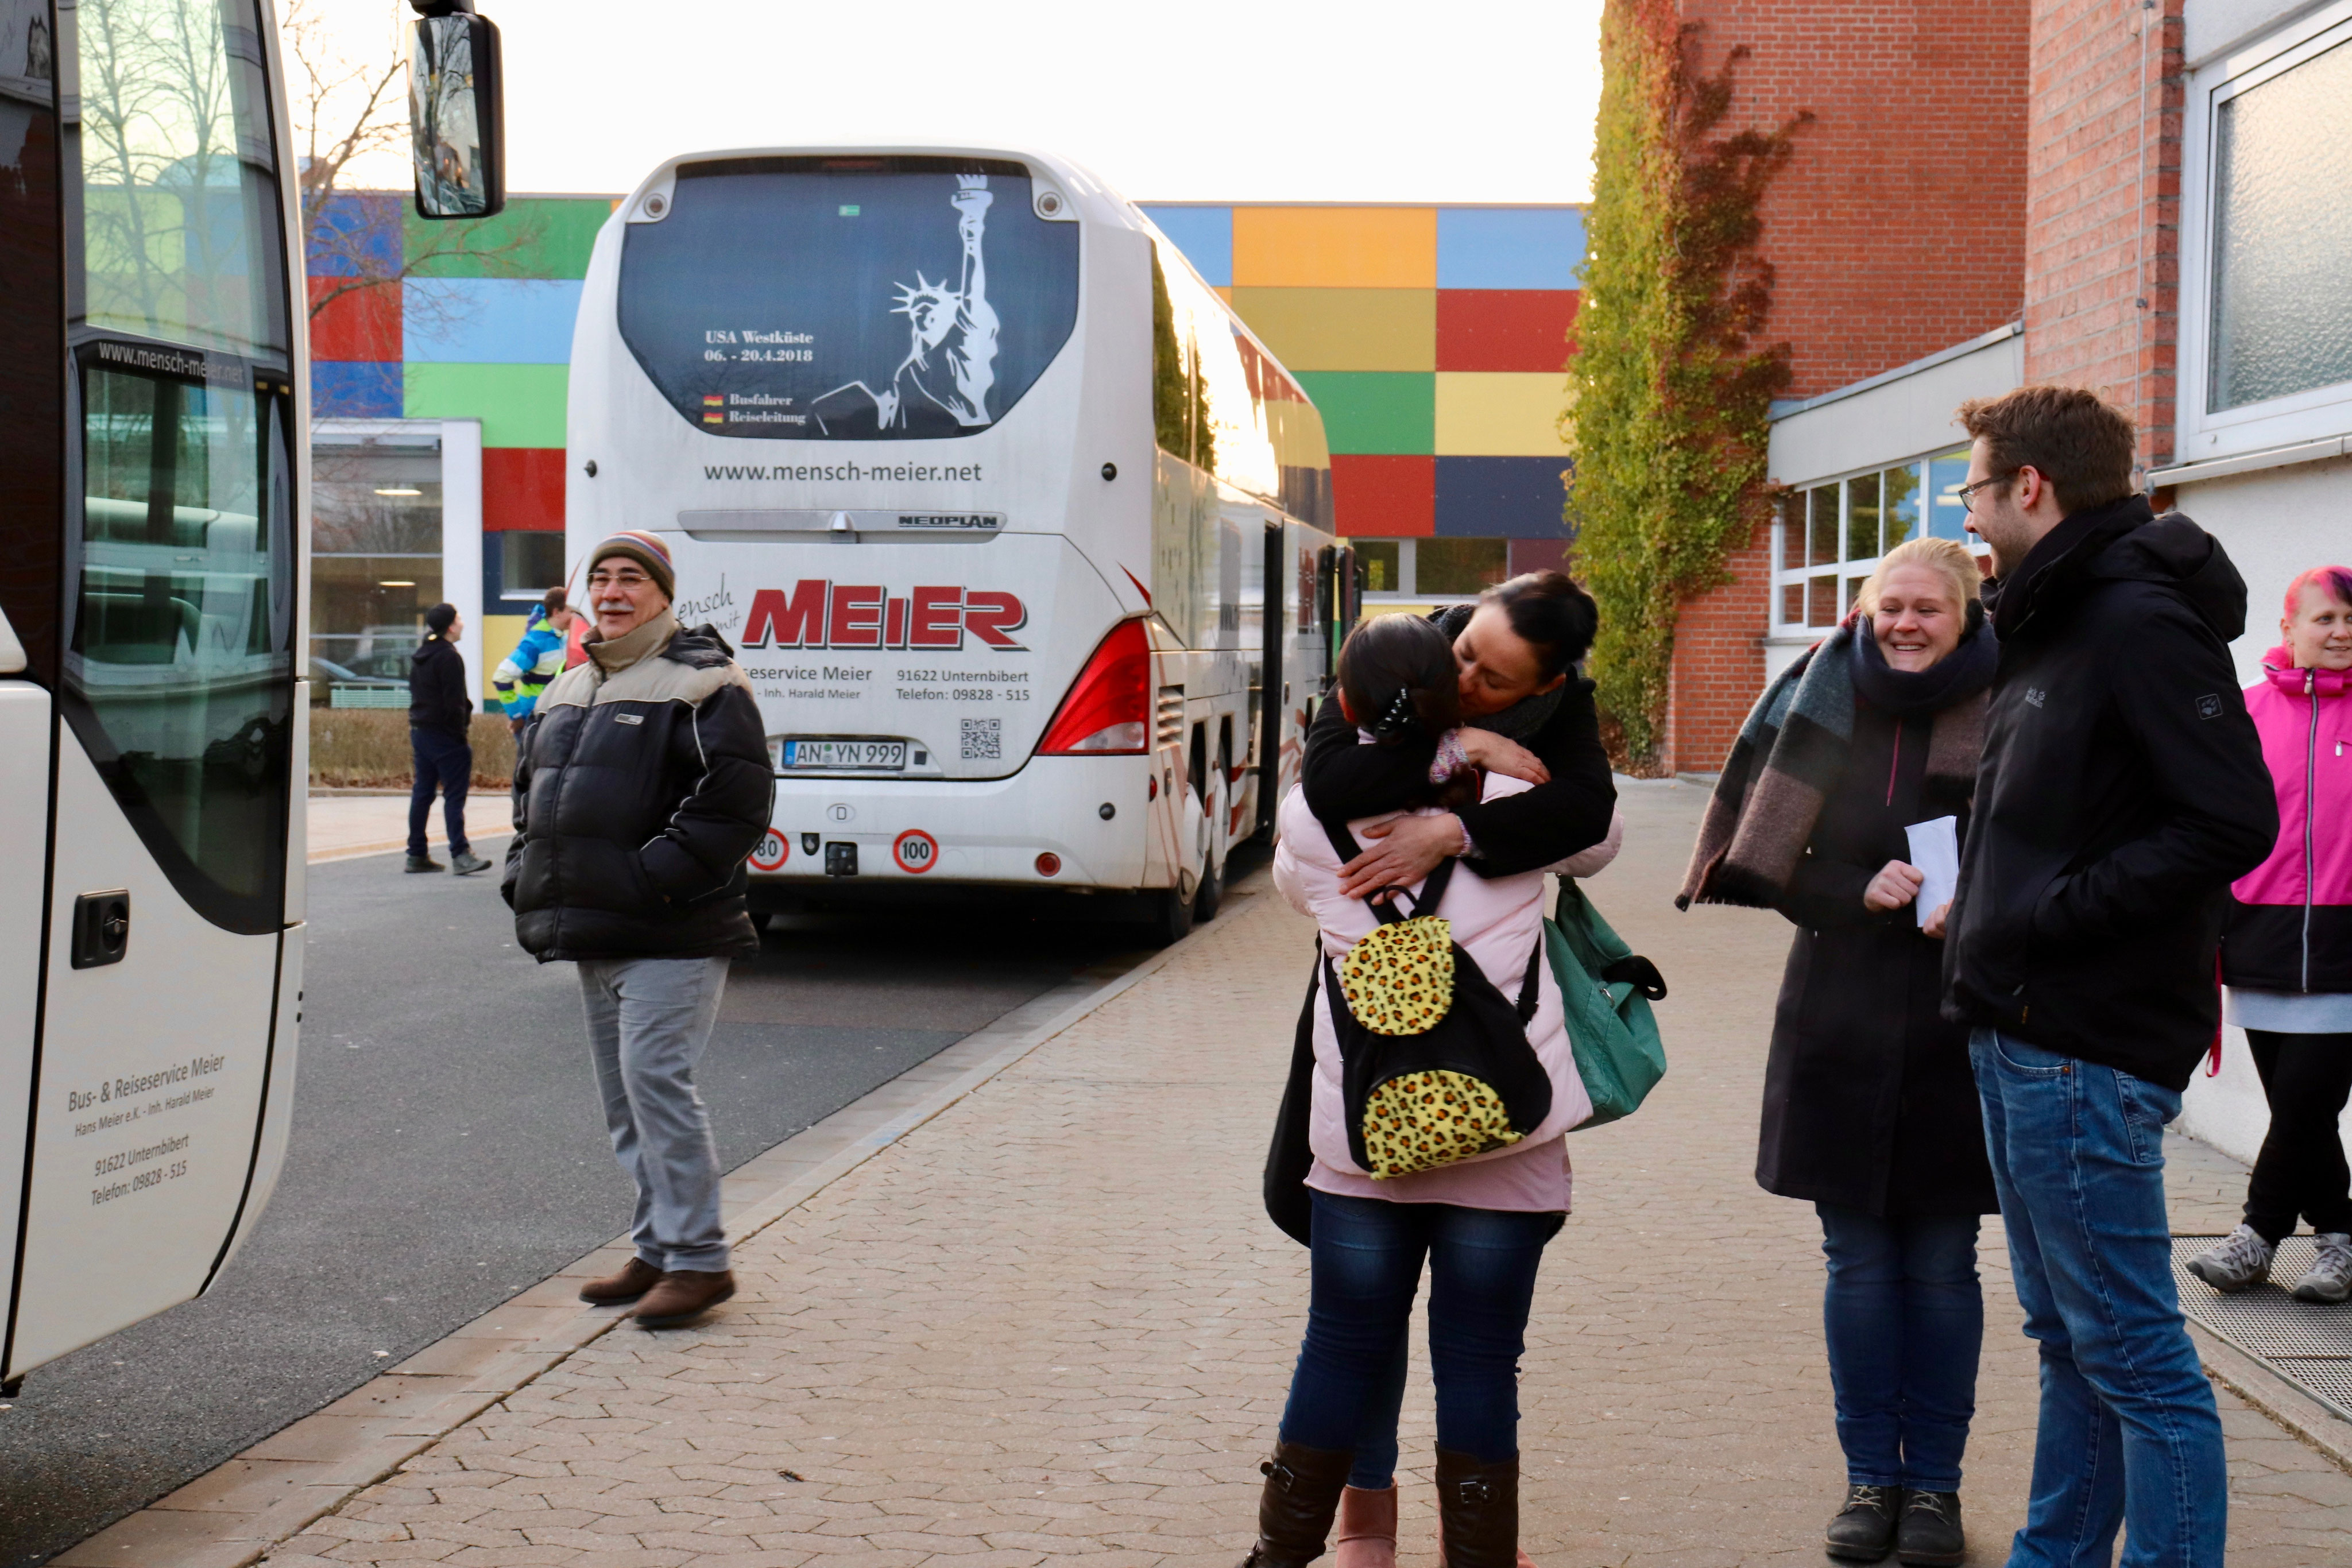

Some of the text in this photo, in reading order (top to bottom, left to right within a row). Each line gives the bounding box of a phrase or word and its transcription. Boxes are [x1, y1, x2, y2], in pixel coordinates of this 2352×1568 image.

[705, 330, 814, 344] USA Westküste
[704, 349, 728, 362] 06.
[741, 349, 813, 362] 20.4.2018
[99, 342, 243, 384] www.mensch-meier.net
[729, 394, 792, 406] Busfahrer
[729, 411, 806, 424] Reiseleitung
[705, 461, 982, 481] www.mensch-meier.net
[899, 515, 997, 528] NEOPLAN
[741, 579, 1032, 652] MEIER
[823, 667, 872, 680] Meier
[897, 670, 1028, 682] 91622 Unternbibert
[764, 689, 785, 698] Inh.
[788, 689, 825, 699] Harald
[828, 690, 861, 699] Meier
[896, 688, 948, 700] Telefon:
[953, 689, 993, 700] 09828
[1007, 690, 1030, 700] 515
[796, 744, 902, 763] AN YN 999
[837, 807, 846, 820] D
[903, 842, 929, 860] 100
[68, 1054, 225, 1112] Bus- & Reiseservice Meier
[75, 1122, 96, 1137] Hans
[99, 1113, 124, 1130] Meier
[126, 1106, 141, 1122] e.K.
[148, 1098, 163, 1116] Inh.
[165, 1090, 191, 1110] Harald
[192, 1086, 215, 1102] Meier
[95, 1133, 189, 1176] 91622 Unternbibert
[92, 1182, 131, 1206] Telefon:
[133, 1168, 162, 1192] 09828
[170, 1160, 187, 1179] 515
